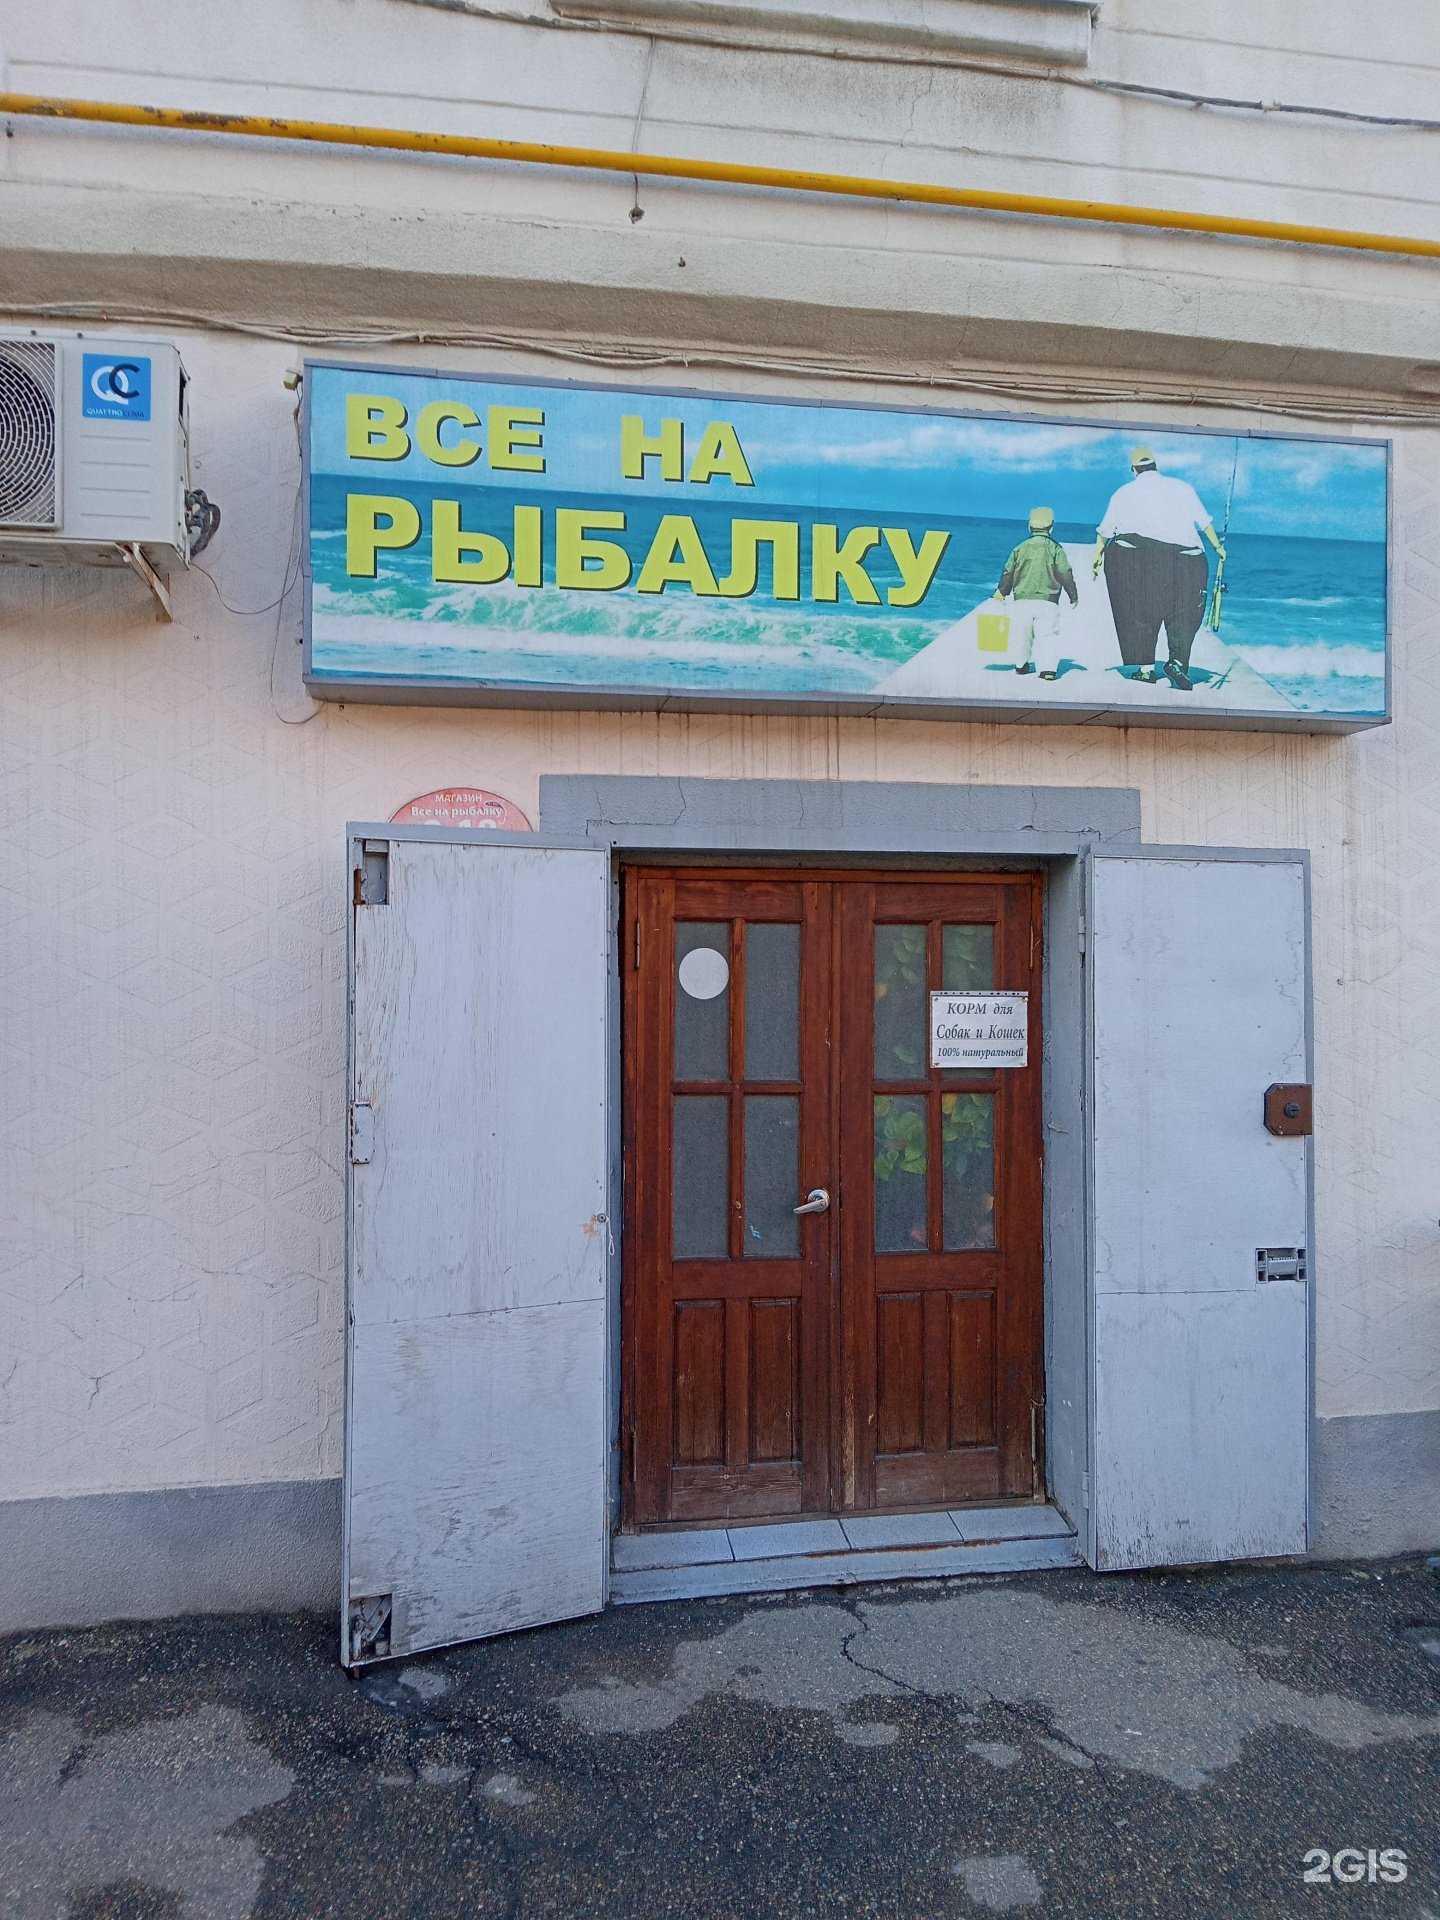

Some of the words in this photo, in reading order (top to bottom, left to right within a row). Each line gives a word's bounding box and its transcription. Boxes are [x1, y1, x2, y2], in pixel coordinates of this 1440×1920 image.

[345, 393, 546, 473] ВСЕ
[620, 414, 755, 487] НА
[345, 493, 951, 608] РЫБАЛКУ
[411, 806, 431, 816] Все
[434, 808, 448, 816] на
[947, 1003, 986, 1015] КОРМ
[993, 1003, 1013, 1015] для
[936, 1024, 971, 1039] Собак
[976, 1030, 983, 1039] и
[988, 1025, 1025, 1039] Кошек
[938, 1048, 960, 1057] 100%
[962, 1048, 1024, 1059] натуральный
